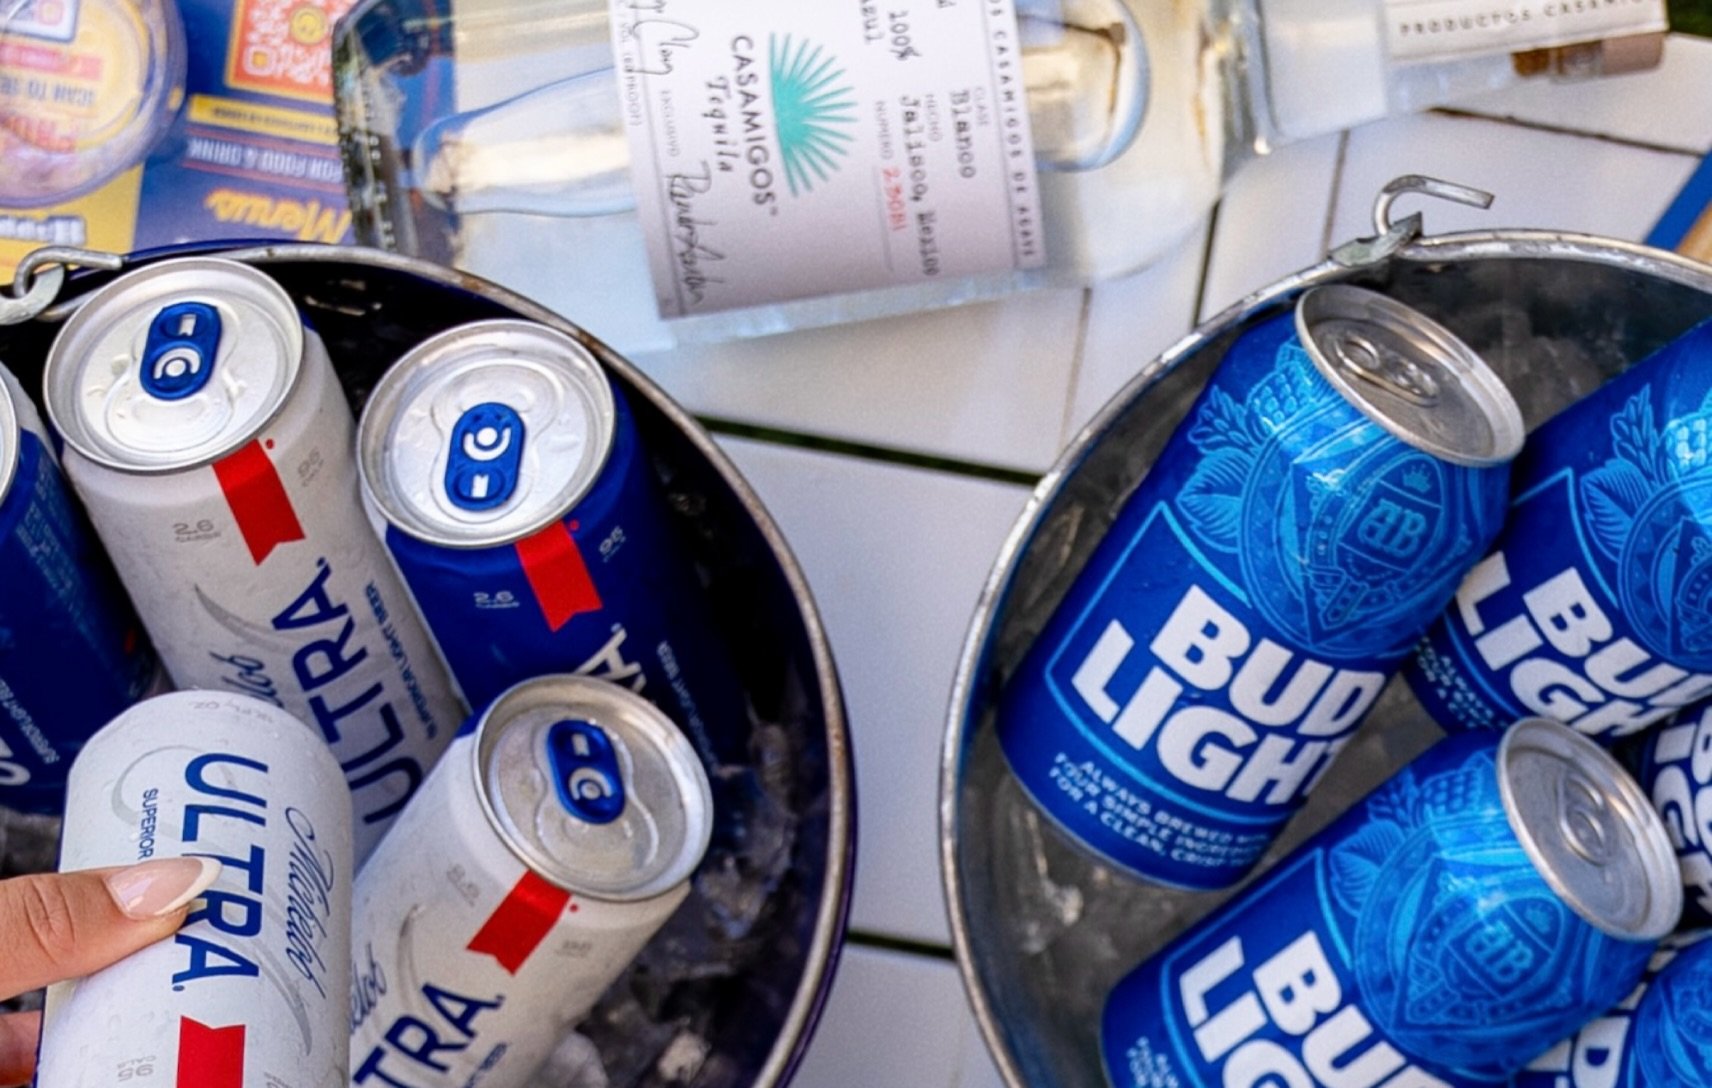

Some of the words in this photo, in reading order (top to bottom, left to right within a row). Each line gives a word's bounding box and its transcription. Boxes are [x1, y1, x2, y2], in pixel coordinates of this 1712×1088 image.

[188, 138, 244, 167] DRINK
[703, 74, 739, 173] Tequila
[731, 34, 775, 206] CASAMIGOS
[950, 89, 977, 179] Blanco
[261, 152, 306, 179] FOOD
[205, 189, 352, 244] Menus
[1150, 584, 1386, 737] BUD
[1456, 550, 1680, 737] LIGH
[270, 562, 424, 825] ULTRA
[137, 787, 159, 860] SUPERIOR
[1079, 760, 1152, 816] ALWAYS
[1083, 799, 1099, 816] A
[172, 752, 269, 986] ULTRA
[116, 1062, 155, 1082] 95
